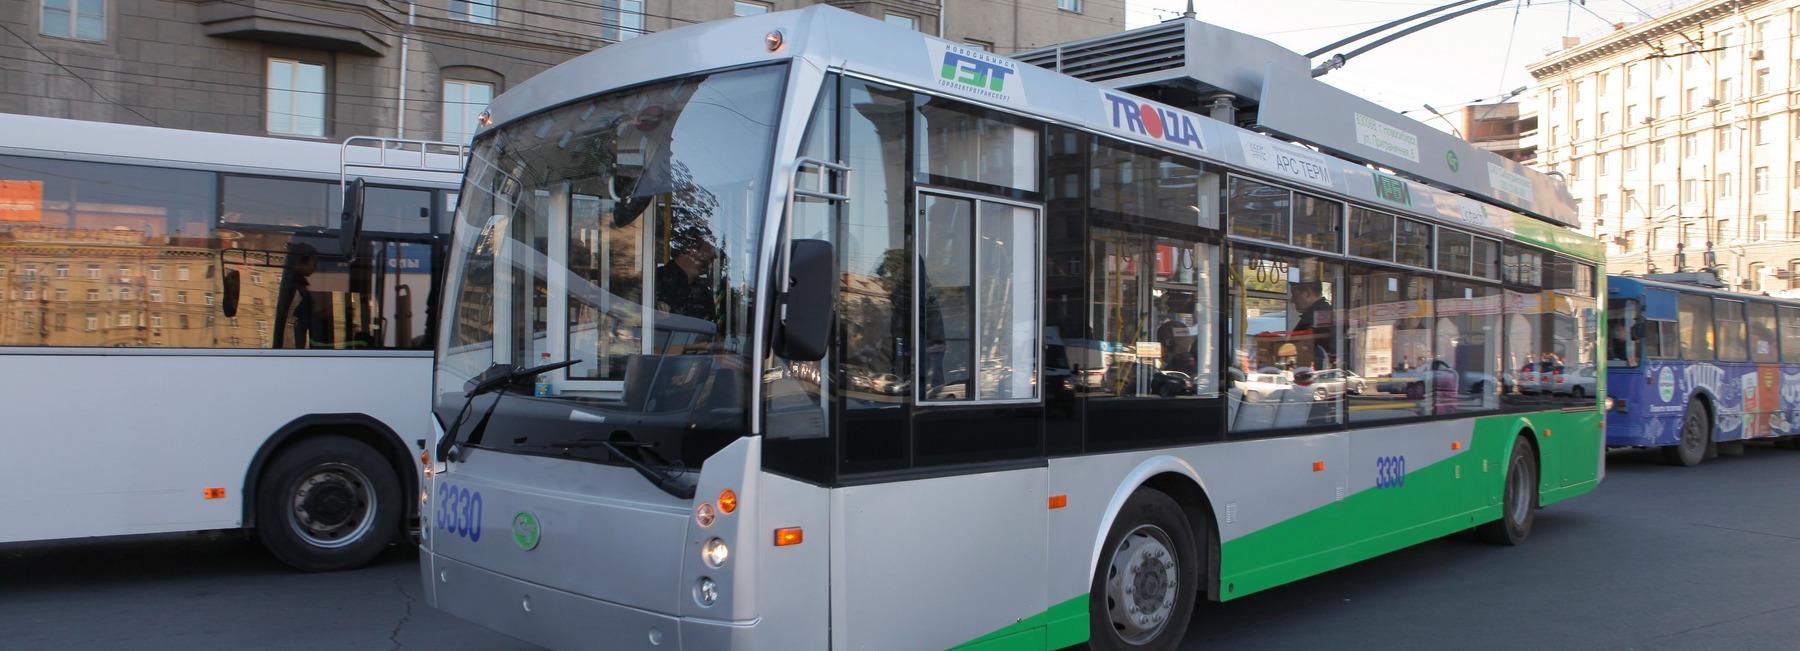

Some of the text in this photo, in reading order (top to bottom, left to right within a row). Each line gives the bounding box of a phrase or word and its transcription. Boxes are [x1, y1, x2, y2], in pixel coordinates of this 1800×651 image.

[945, 44, 1015, 69] НОВОСИБИРСК
[938, 79, 1010, 102] ГОРЭЛЕКТРОТРАНСПОРТ
[1104, 92, 1204, 150] TROLZA
[1276, 154, 1300, 175] АРС
[1299, 160, 1331, 183] ТЕРМ
[1376, 455, 1406, 489] 3330
[437, 481, 483, 543] 3330
